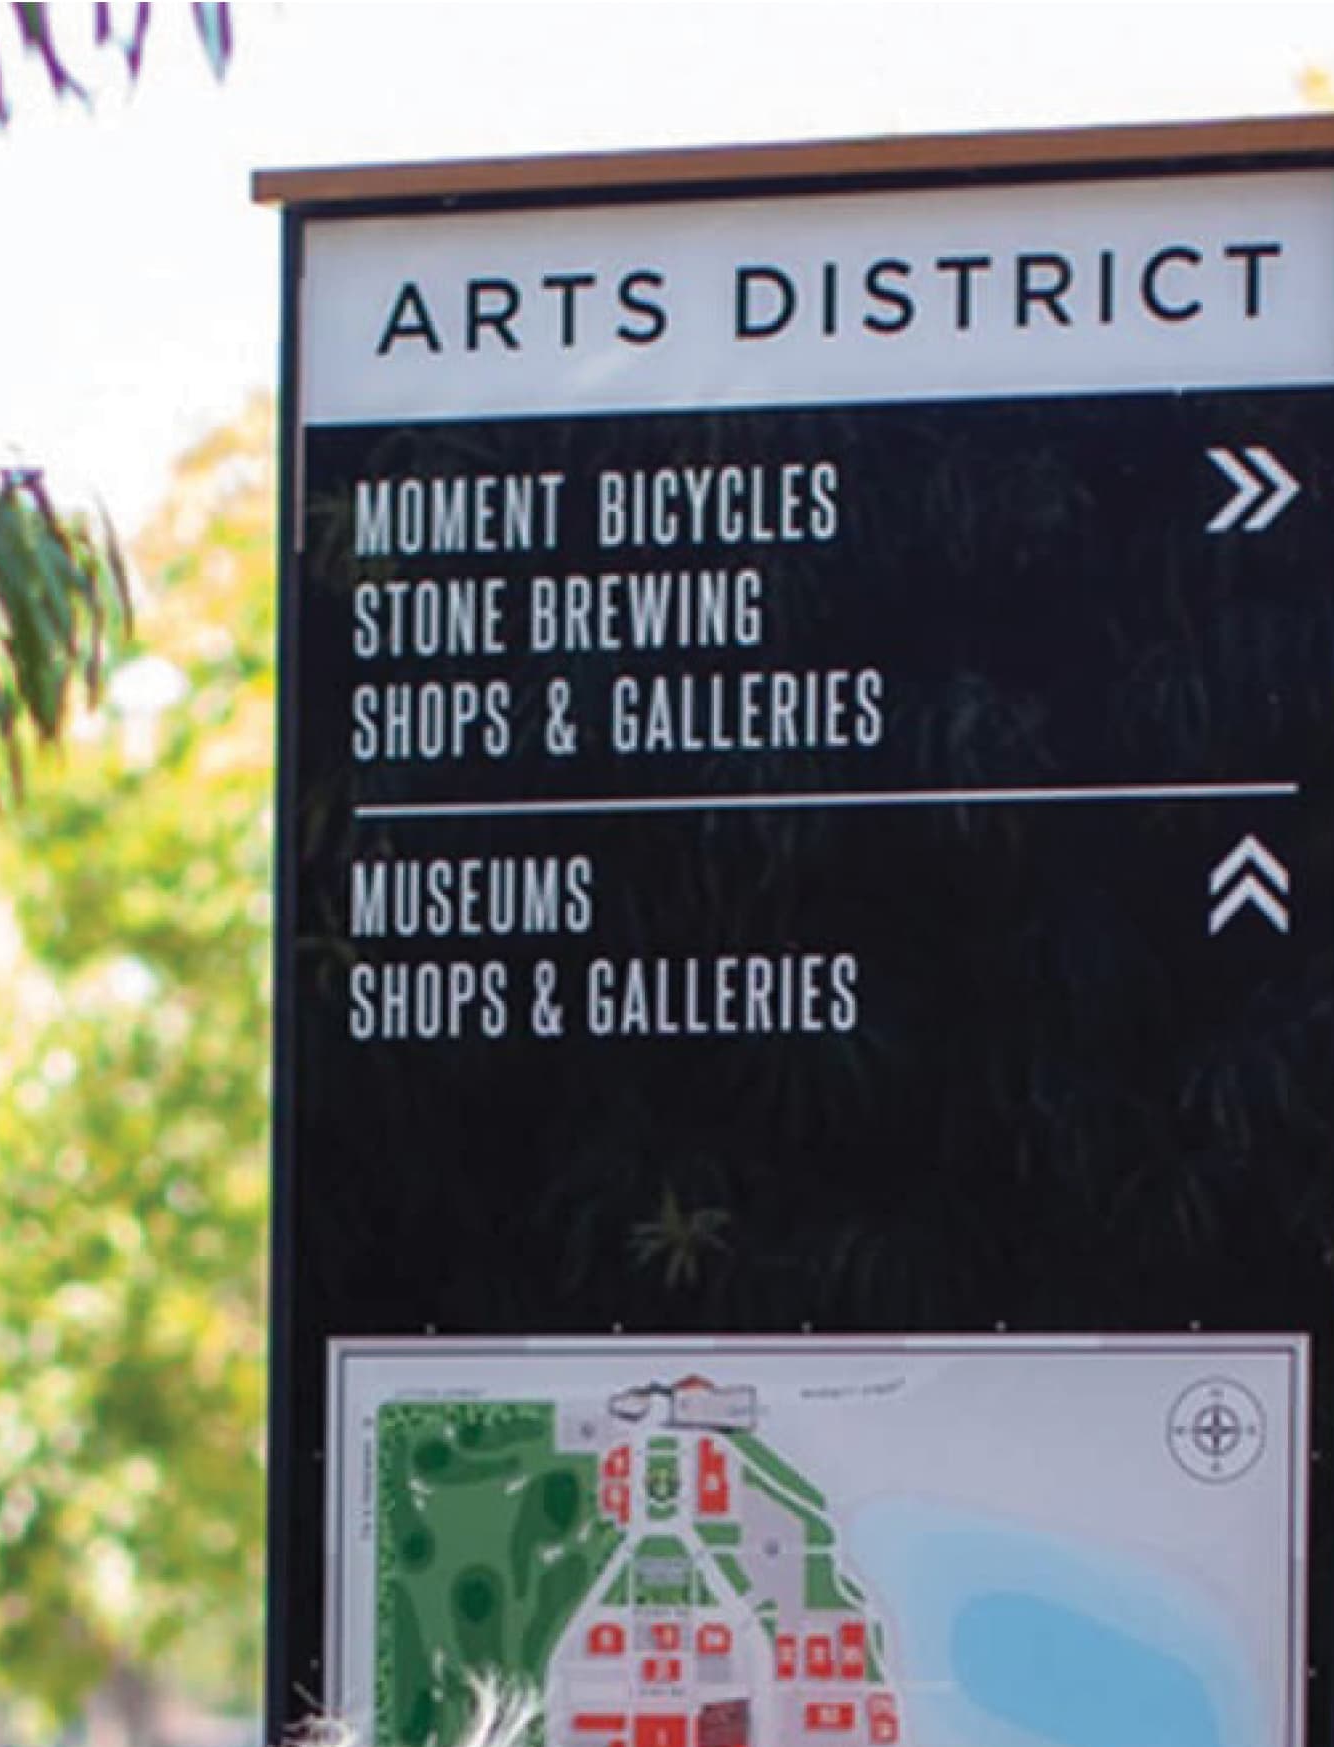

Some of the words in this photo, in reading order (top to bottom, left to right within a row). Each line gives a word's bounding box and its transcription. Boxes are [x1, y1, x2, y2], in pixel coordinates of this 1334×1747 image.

[377, 271, 667, 356] ARTS
[734, 243, 1282, 340] DISTRICT
[355, 474, 564, 555] MOMENT
[599, 463, 837, 545] BICYCLES
[354, 578, 505, 657] STONE
[532, 569, 760, 651] BREWING
[354, 681, 510, 760] SHOPS
[546, 679, 576, 755] &
[613, 669, 881, 752] GALLERIES
[352, 856, 590, 936] MUSEUMS
[351, 962, 505, 1039] SHOPS
[532, 960, 561, 1036] &
[589, 954, 856, 1034] GALLERIES
